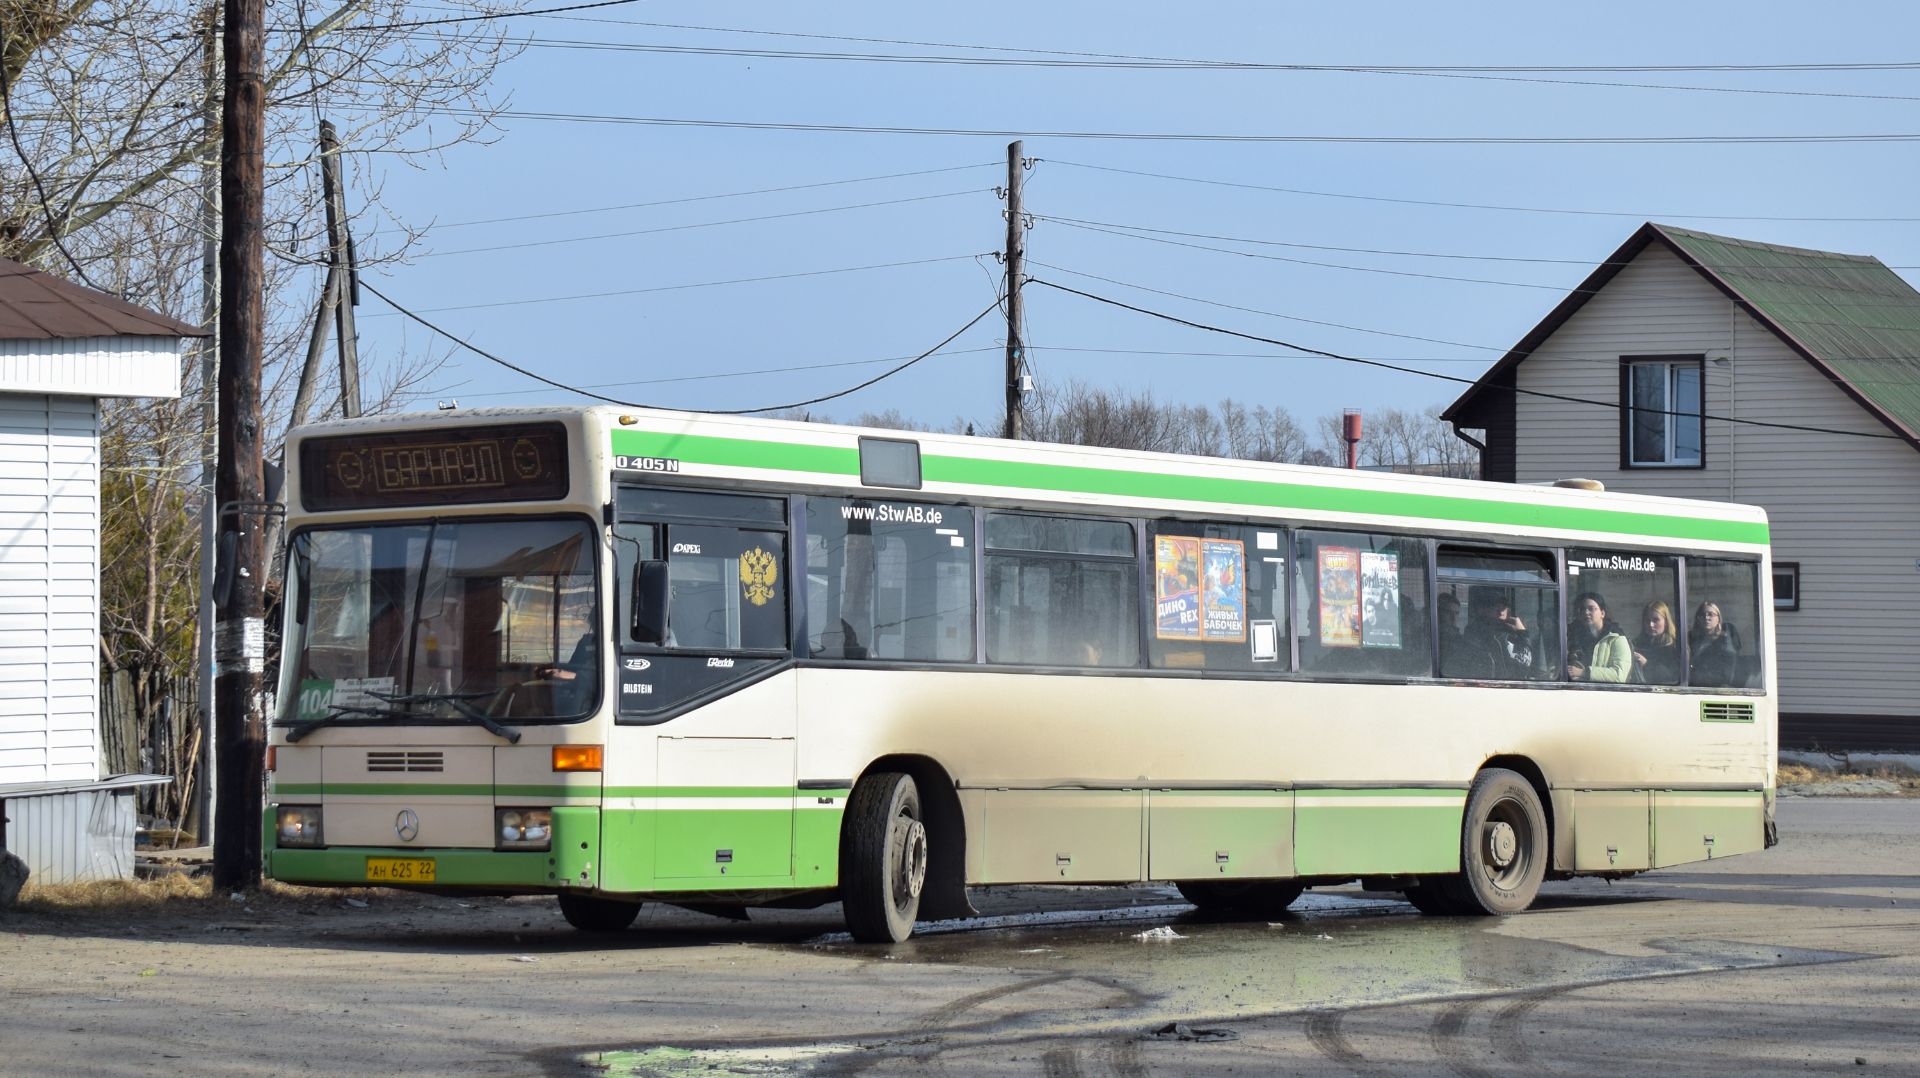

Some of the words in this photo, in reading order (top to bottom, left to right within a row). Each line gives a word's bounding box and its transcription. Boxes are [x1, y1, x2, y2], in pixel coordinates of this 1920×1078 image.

[382, 446, 497, 486] БАРНАУЛ
[631, 457, 665, 471] 405
[666, 459, 678, 472] N
[841, 504, 943, 524] www.StwAB.de
[1586, 556, 1656, 572] www.StwAB.de
[1158, 599, 1187, 617] ДИНО
[1208, 610, 1239, 620] ЖИВЫХ
[1180, 609, 1198, 624] REX
[1203, 619, 1243, 631] БАБОЧЕК
[623, 683, 652, 694] BILSTEIN
[299, 689, 333, 714] 104
[391, 862, 412, 878] 625
[419, 862, 431, 874] 22
